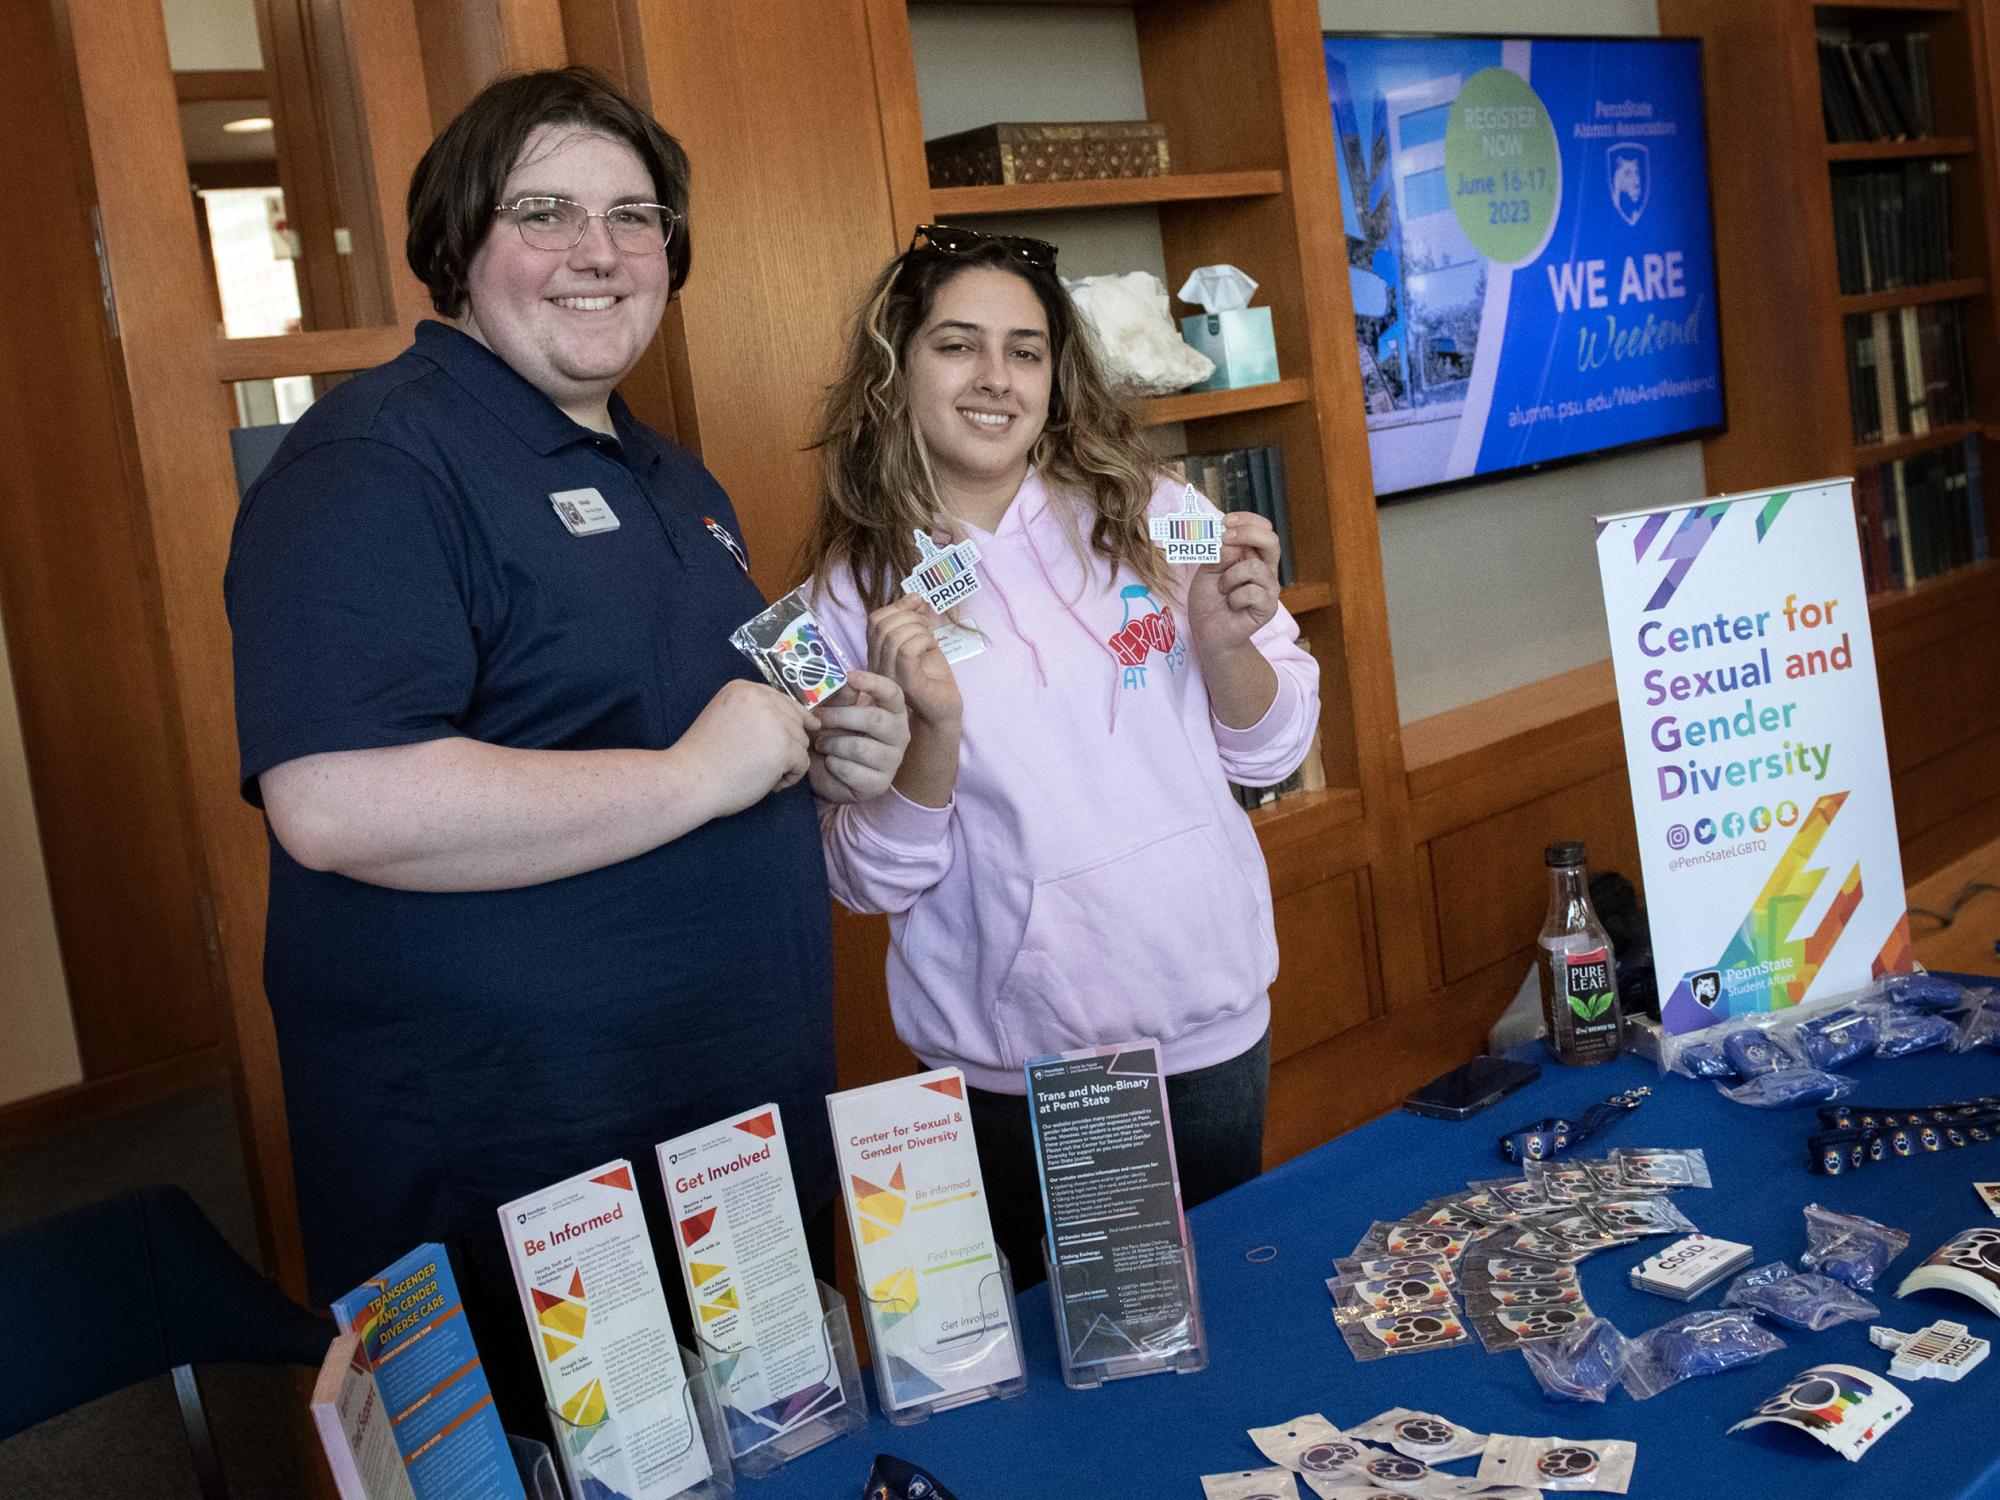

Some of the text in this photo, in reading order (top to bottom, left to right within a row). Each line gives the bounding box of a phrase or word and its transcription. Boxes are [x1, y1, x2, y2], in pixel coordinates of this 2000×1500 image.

[1464, 106, 1537, 129] REGISTER
[1482, 134, 1524, 157] NOW
[1456, 174, 1495, 196] June
[1488, 200, 1530, 225] 2023
[1547, 251, 1686, 313] WE ARE
[1577, 294, 1704, 372] Weekend
[1168, 543, 1218, 555] PRIDE
[930, 573, 976, 606] PRIDE
[937, 583, 979, 612] AT PENN STATE
[1638, 594, 1839, 658] Center for
[1123, 631, 1186, 690] AT PSU
[1644, 633, 1853, 706] Sexual and
[1651, 698, 1797, 752] Gender
[1657, 741, 1832, 801] Diversity
[1669, 839, 1767, 872] @PennStateLGBTQ
[1571, 965, 1606, 980] PURE
[1727, 957, 1794, 982] PennState
[1572, 977, 1606, 992] LEAF
[1728, 973, 1797, 997] Student Affairs
[1037, 1076, 1149, 1102] Trans and Non-Binary
[1039, 1094, 1110, 1113] at Penn State
[850, 1112, 964, 1147] Center for Sexual &
[860, 1130, 958, 1160] Gender Diversity
[675, 1172, 705, 1194] Get
[708, 1143, 771, 1181] Involved
[915, 1177, 971, 1200] Be informed
[523, 1239, 546, 1257] Be
[549, 1202, 623, 1246] Informed
[927, 1241, 985, 1263] Find support
[1658, 1244, 1706, 1270] CSGD
[368, 1263, 437, 1313] TRANSGENDER
[377, 1281, 438, 1328] AND GENDER
[379, 1314, 420, 1345] DIVERSE
[420, 1295, 446, 1318] CARE
[941, 1308, 999, 1333] Get involved
[1937, 1337, 1977, 1366] PRIDE
